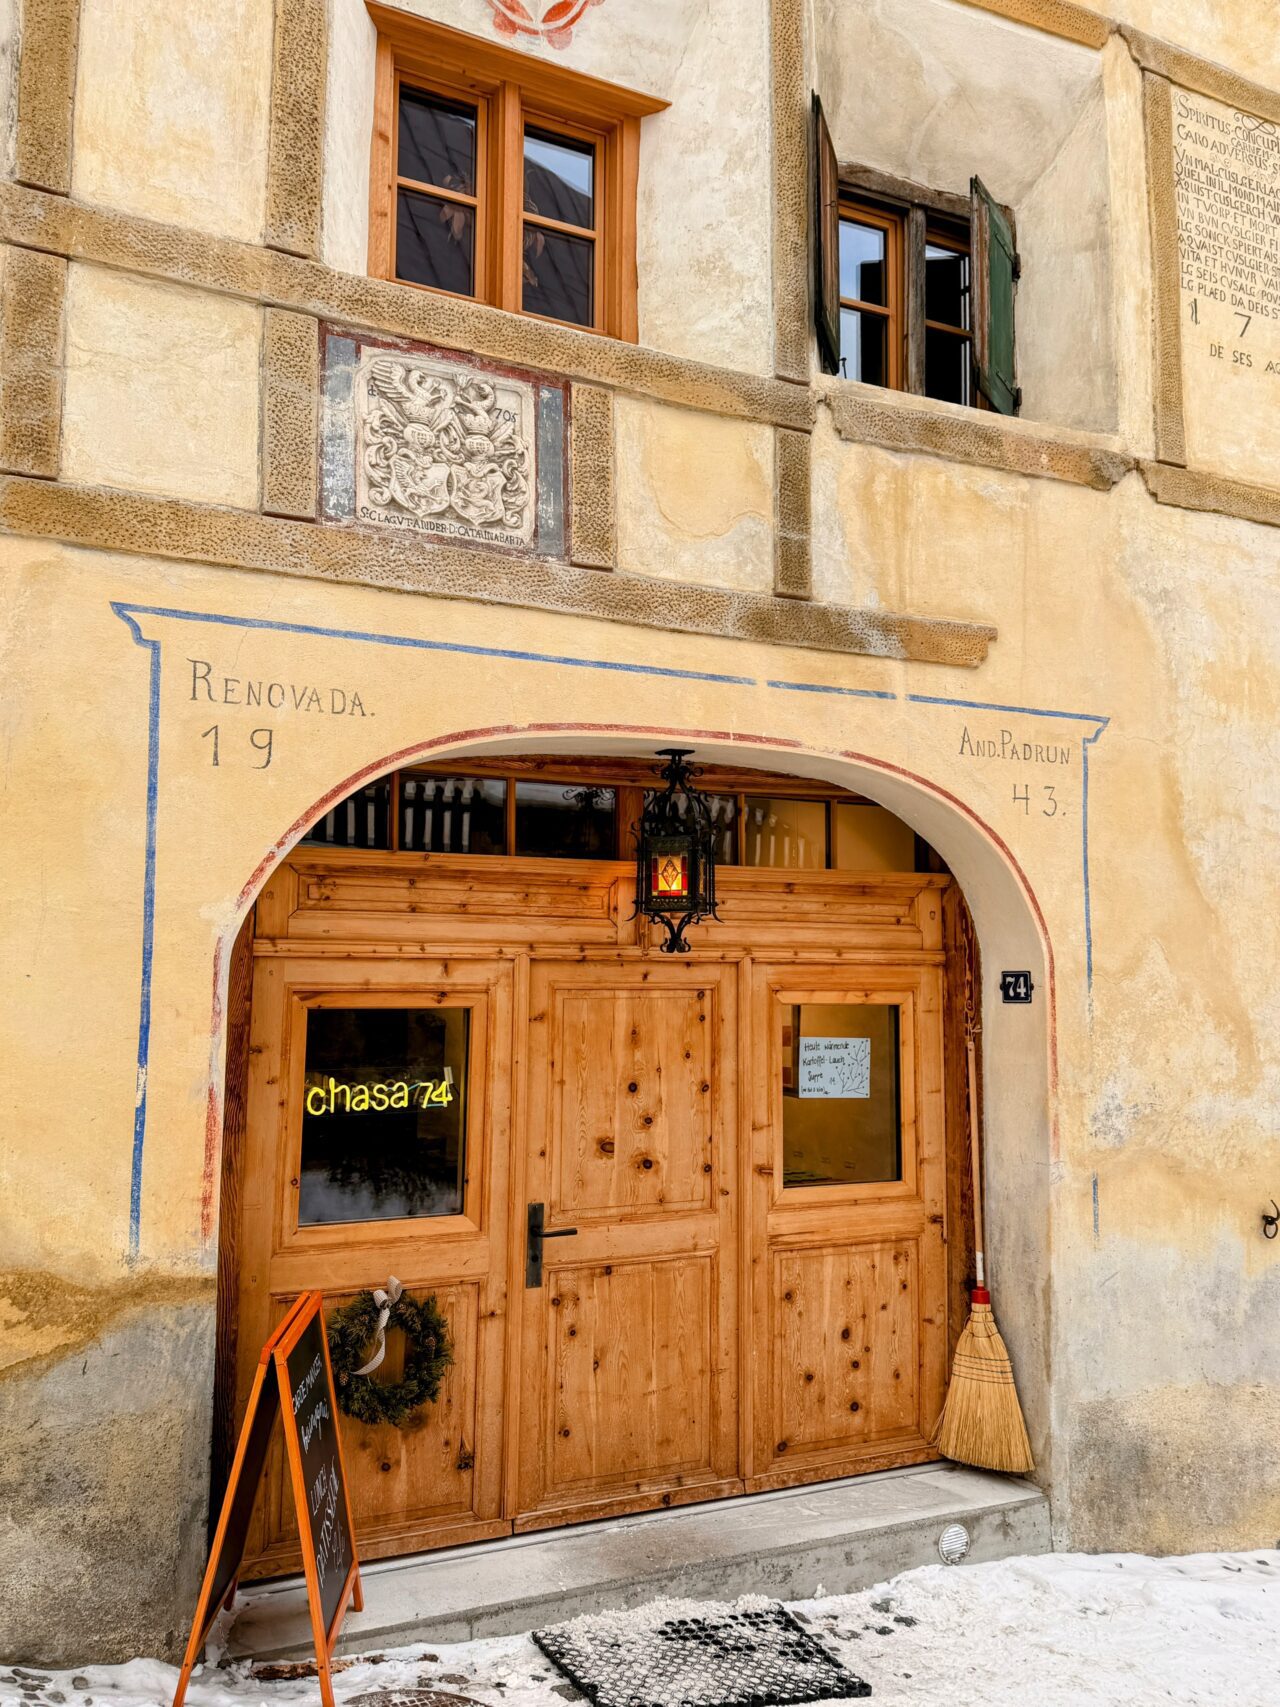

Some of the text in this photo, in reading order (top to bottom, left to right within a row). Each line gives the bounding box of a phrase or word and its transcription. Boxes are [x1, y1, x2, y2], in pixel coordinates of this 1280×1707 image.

[1177, 191, 1190, 205] IN
[1233, 212, 1247, 226] ET
[1249, 217, 1277, 237] MORT
[1179, 204, 1194, 220] VN
[1232, 239, 1263, 259] SPIERT
[1179, 247, 1202, 264] VITA
[1205, 256, 1217, 269] ET
[1221, 261, 1257, 285] HVNVR
[1196, 267, 1218, 284] SEIS
[1231, 294, 1246, 310] DA
[1248, 300, 1270, 317] DEIS
[1210, 343, 1224, 359] DE
[1232, 350, 1253, 368] SES
[1005, 976, 1027, 998] 74
[307, 1077, 453, 1115] chasa 74
